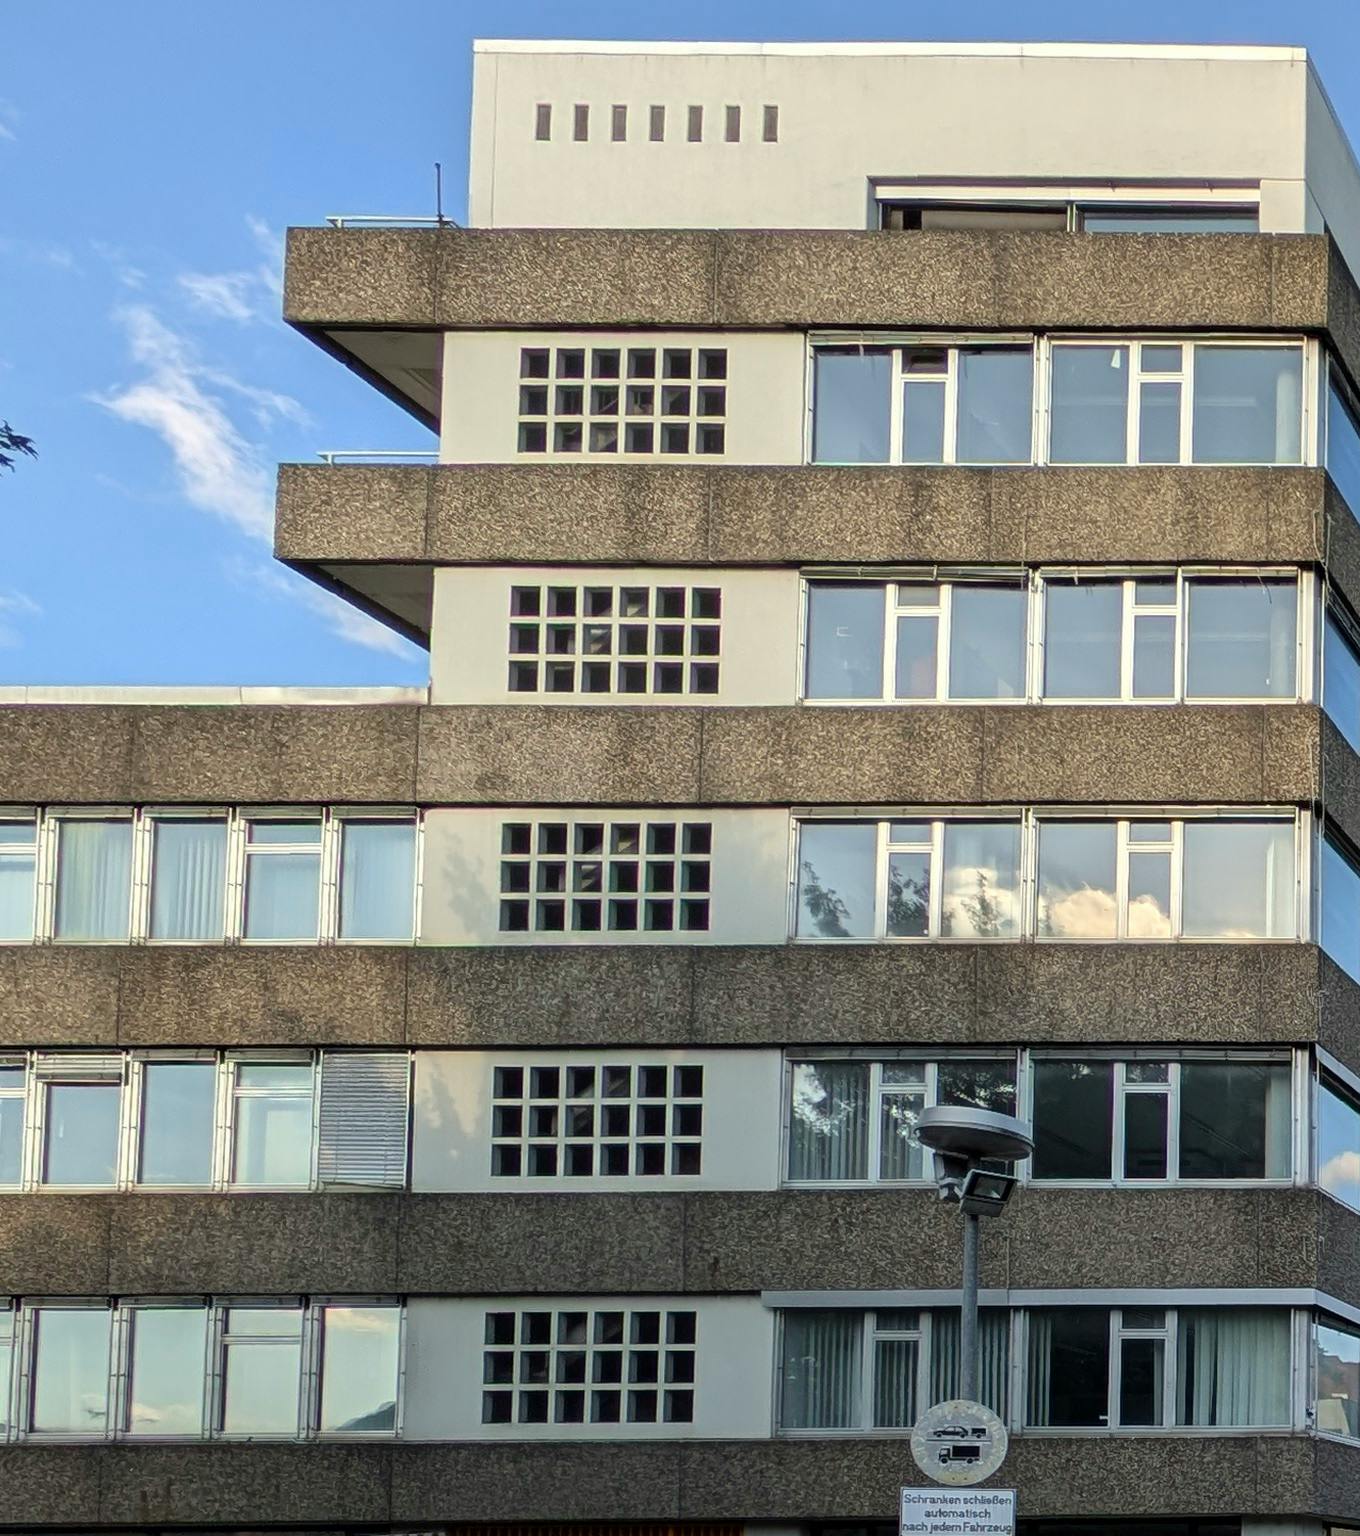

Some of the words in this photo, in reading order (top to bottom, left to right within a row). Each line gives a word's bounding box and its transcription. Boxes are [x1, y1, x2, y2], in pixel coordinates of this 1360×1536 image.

[903, 1493, 961, 1505] Schranken
[963, 1495, 1012, 1505] schließen
[924, 1508, 991, 1519] automatisch
[902, 1522, 929, 1532] nach
[929, 1522, 962, 1534] jedem
[963, 1522, 1012, 1535] Fahrzeug
